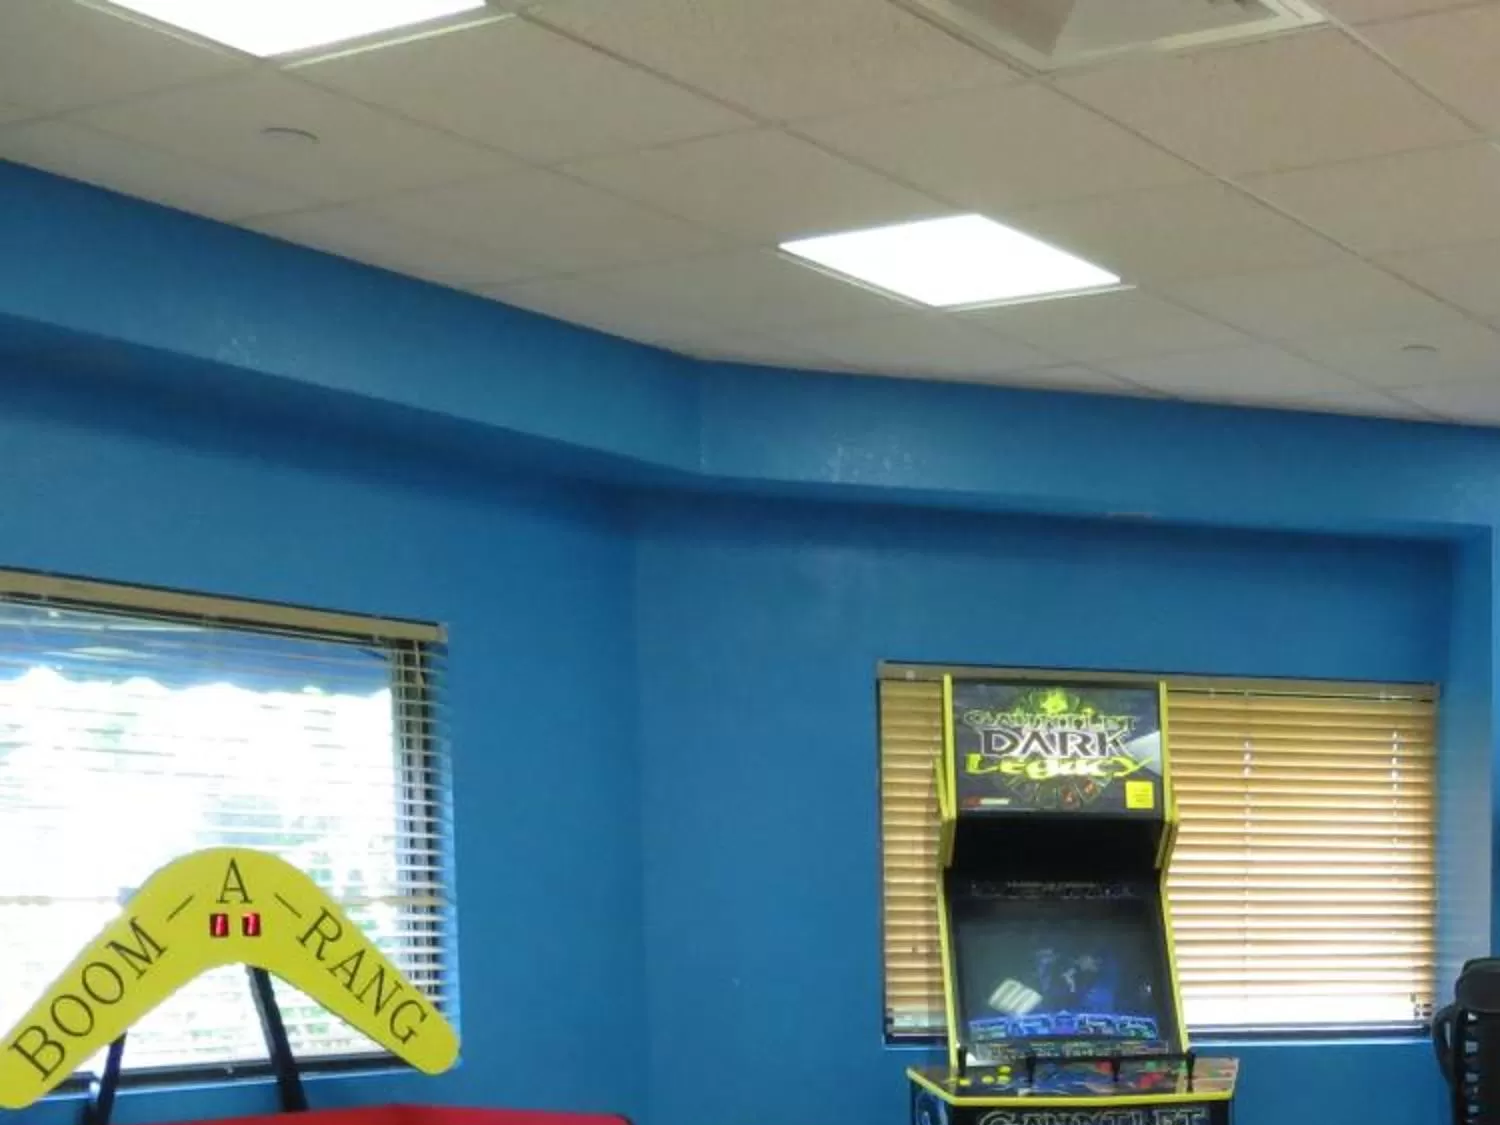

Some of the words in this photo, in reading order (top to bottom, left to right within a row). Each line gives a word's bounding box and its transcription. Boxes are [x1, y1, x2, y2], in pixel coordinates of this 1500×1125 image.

[980, 727, 1135, 758] DARK
[8, 916, 168, 1082] BOOM
[216, 857, 254, 905] A
[295, 907, 430, 1045] RANG
